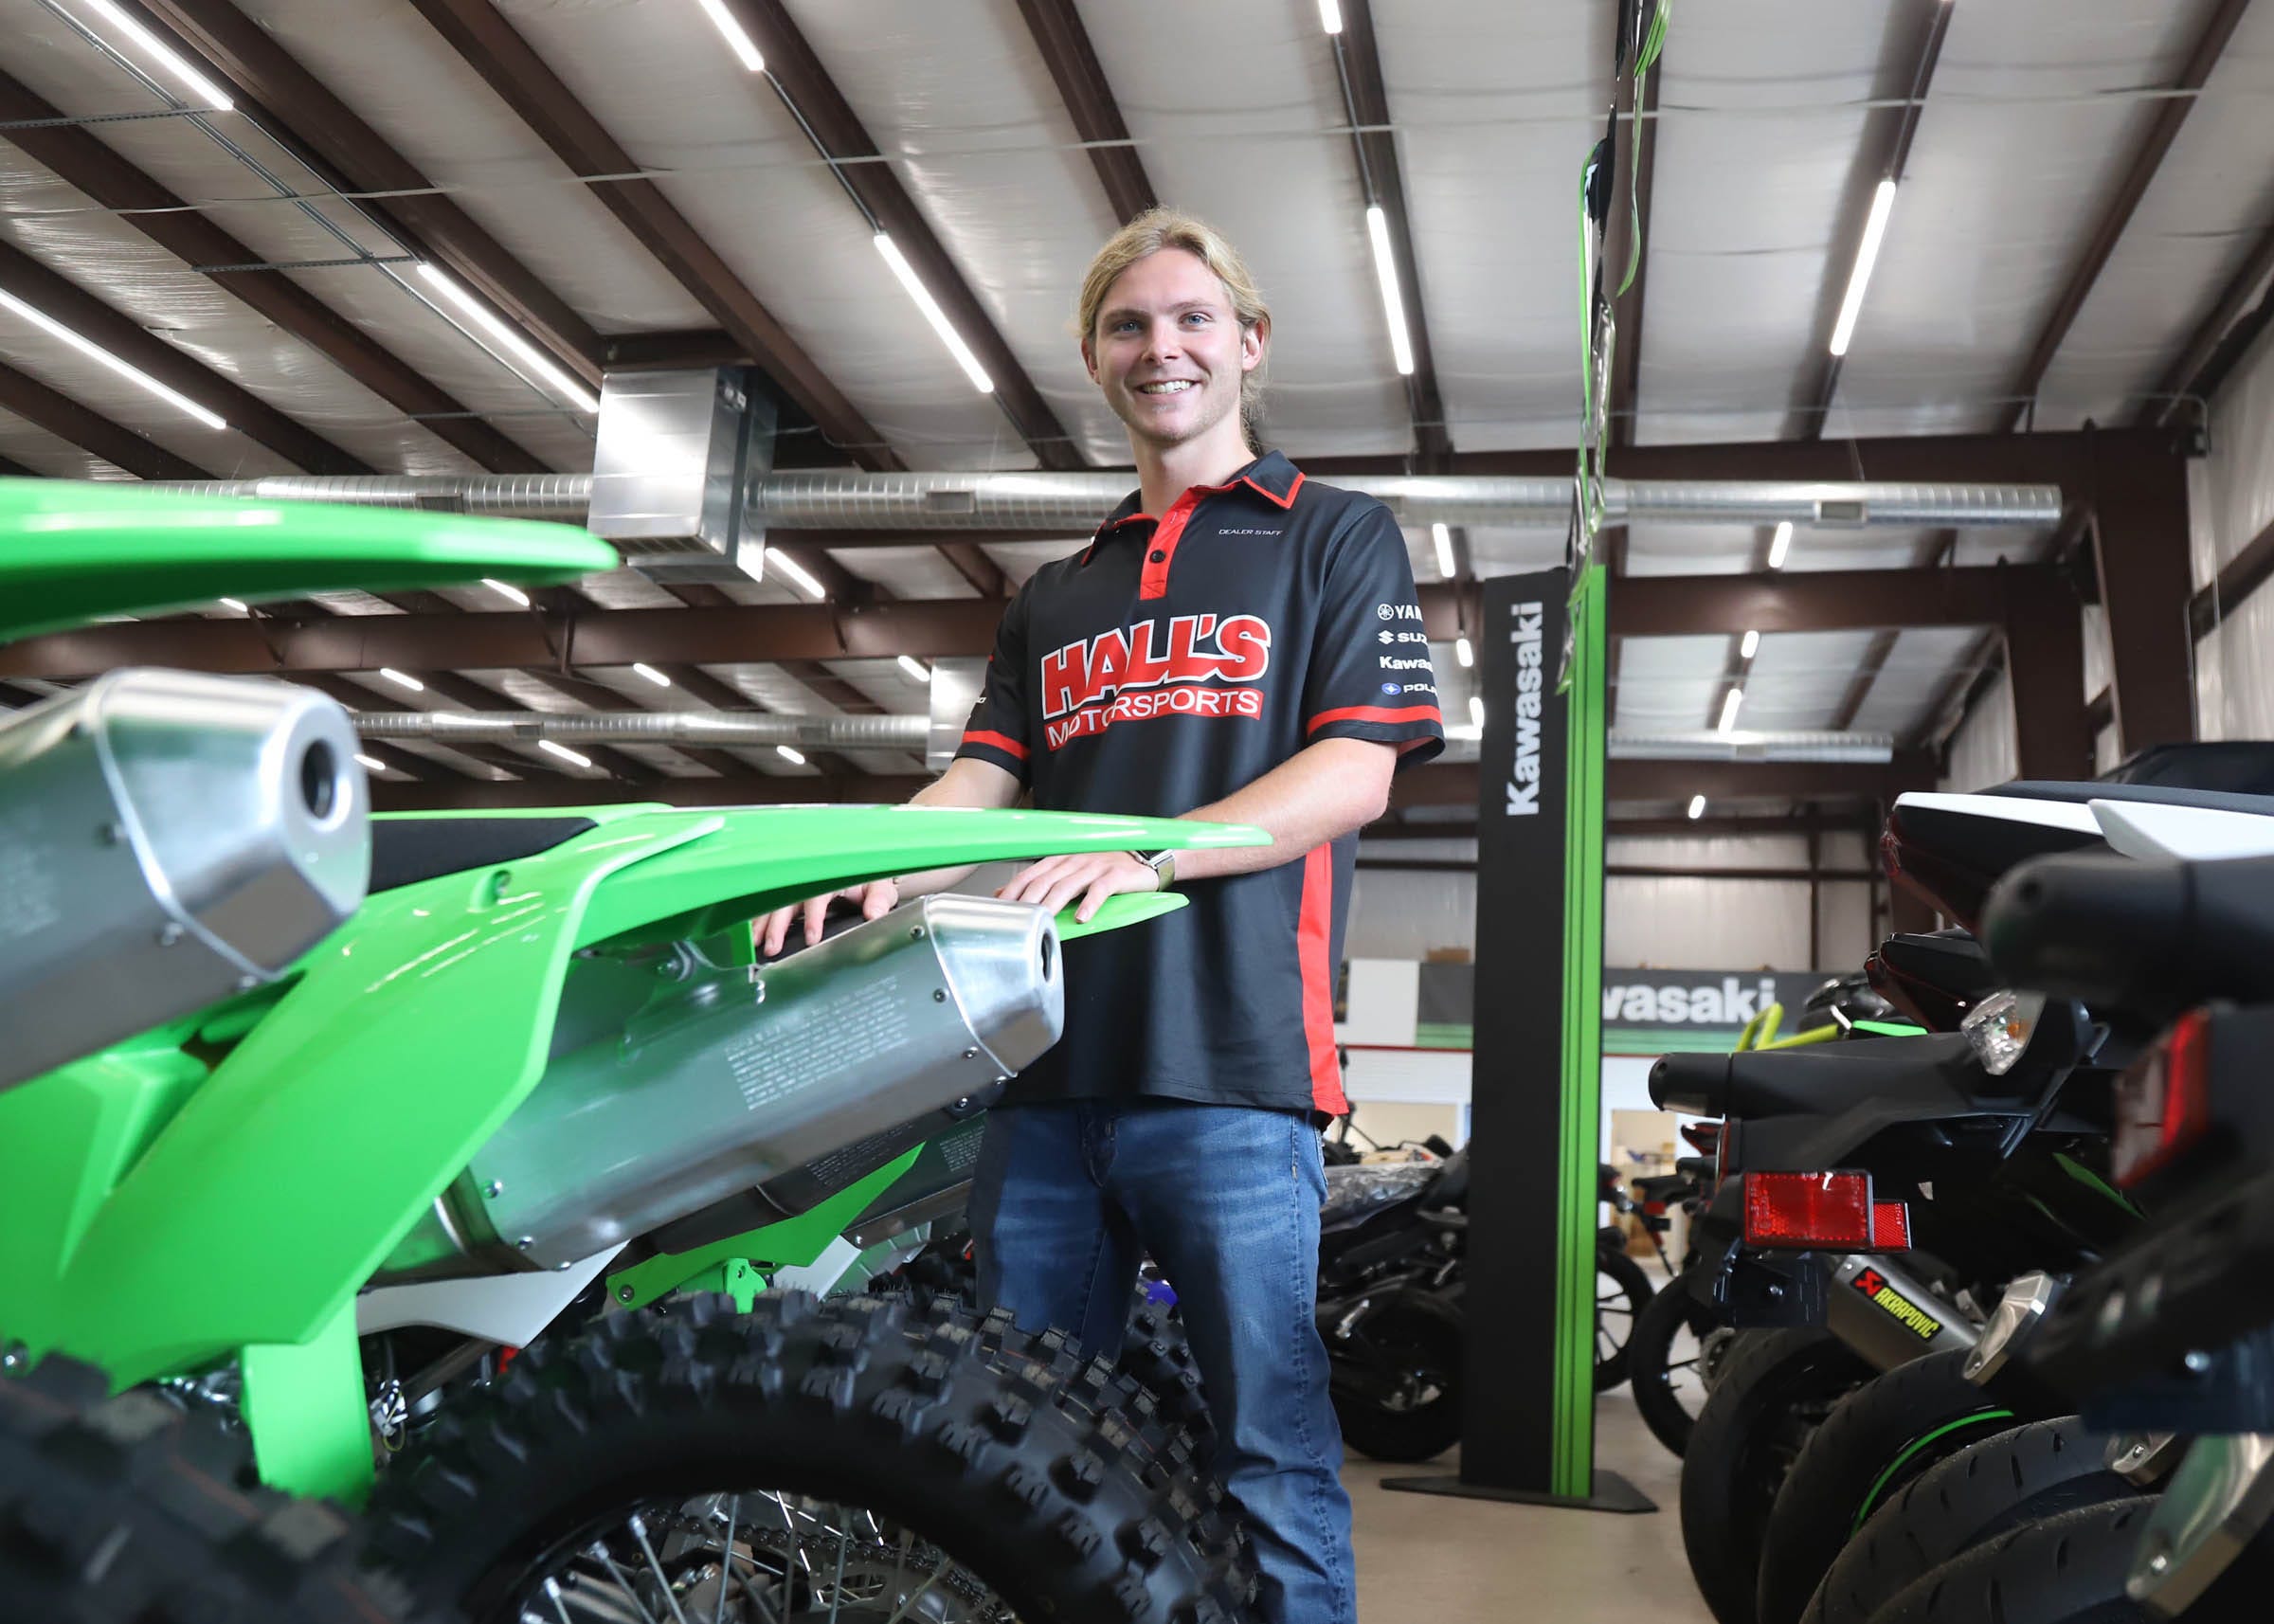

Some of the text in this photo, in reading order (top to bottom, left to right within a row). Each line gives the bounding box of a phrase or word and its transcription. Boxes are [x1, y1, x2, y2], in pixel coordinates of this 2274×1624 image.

[1041, 614, 1272, 720] HALL'S
[1048, 688, 1259, 747] MOTORSPORTS
[1507, 602, 1543, 816] Kawasaki
